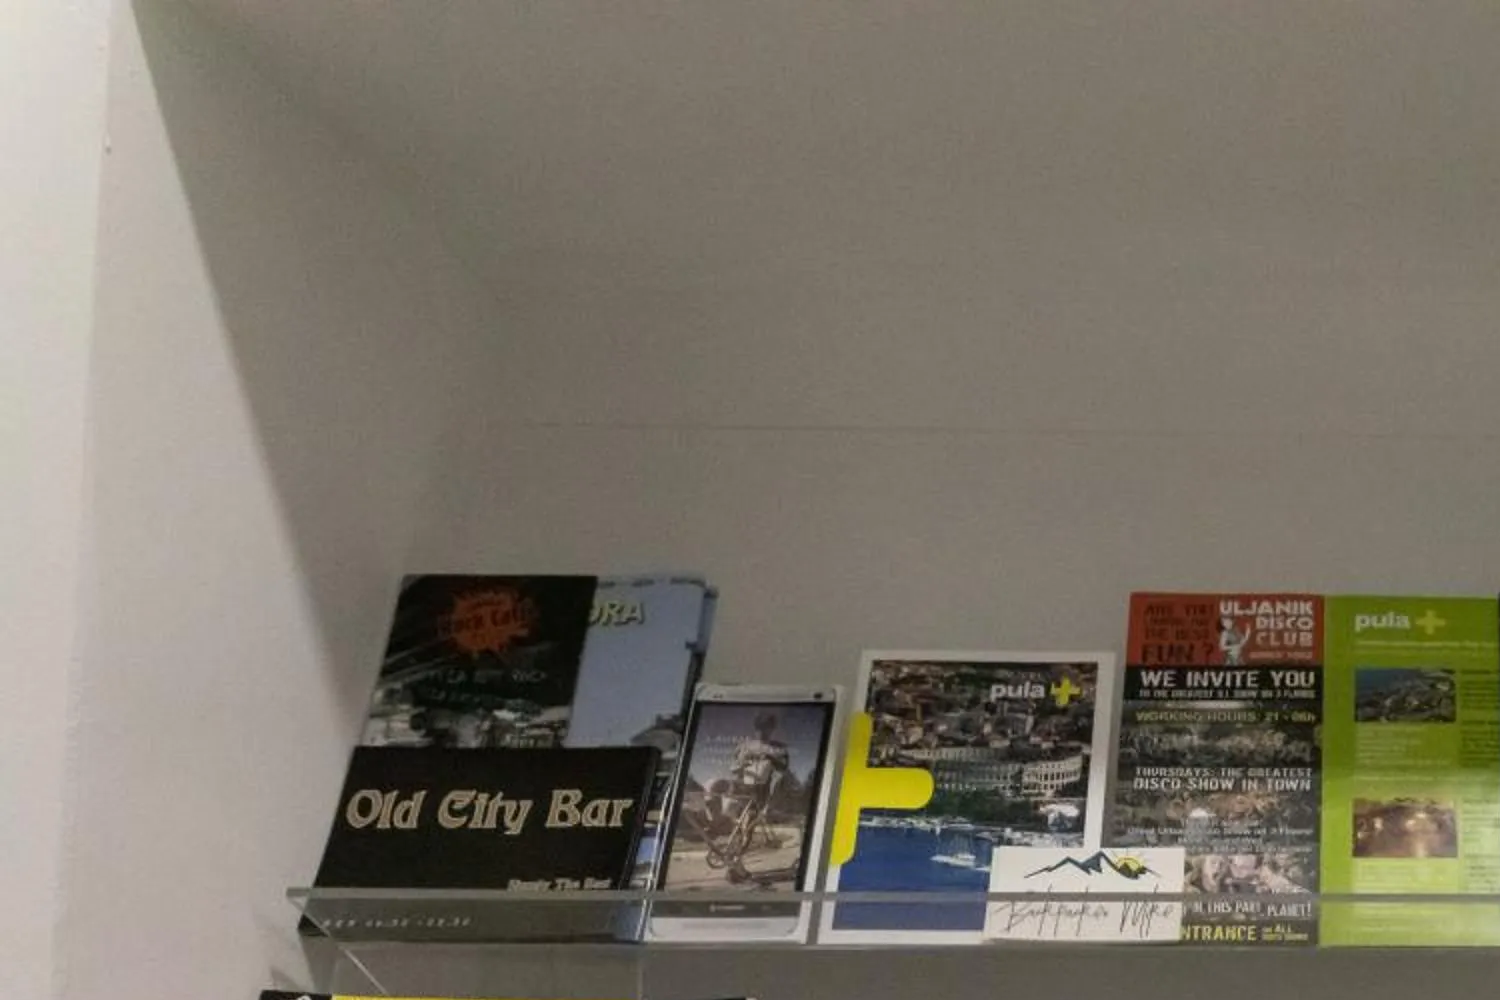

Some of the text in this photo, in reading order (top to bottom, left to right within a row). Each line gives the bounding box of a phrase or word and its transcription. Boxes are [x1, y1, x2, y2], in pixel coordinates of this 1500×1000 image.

[1220, 601, 1313, 617] ULJANIK
[1256, 617, 1313, 630] DISCO
[1256, 632, 1313, 646] CLUB
[1140, 670, 1315, 687] WE INVITE YOU
[1133, 777, 1312, 791] DISCO SHOW IN TOWN
[345, 788, 633, 835] Old City Bar
[1180, 924, 1257, 941] NTRANCE
